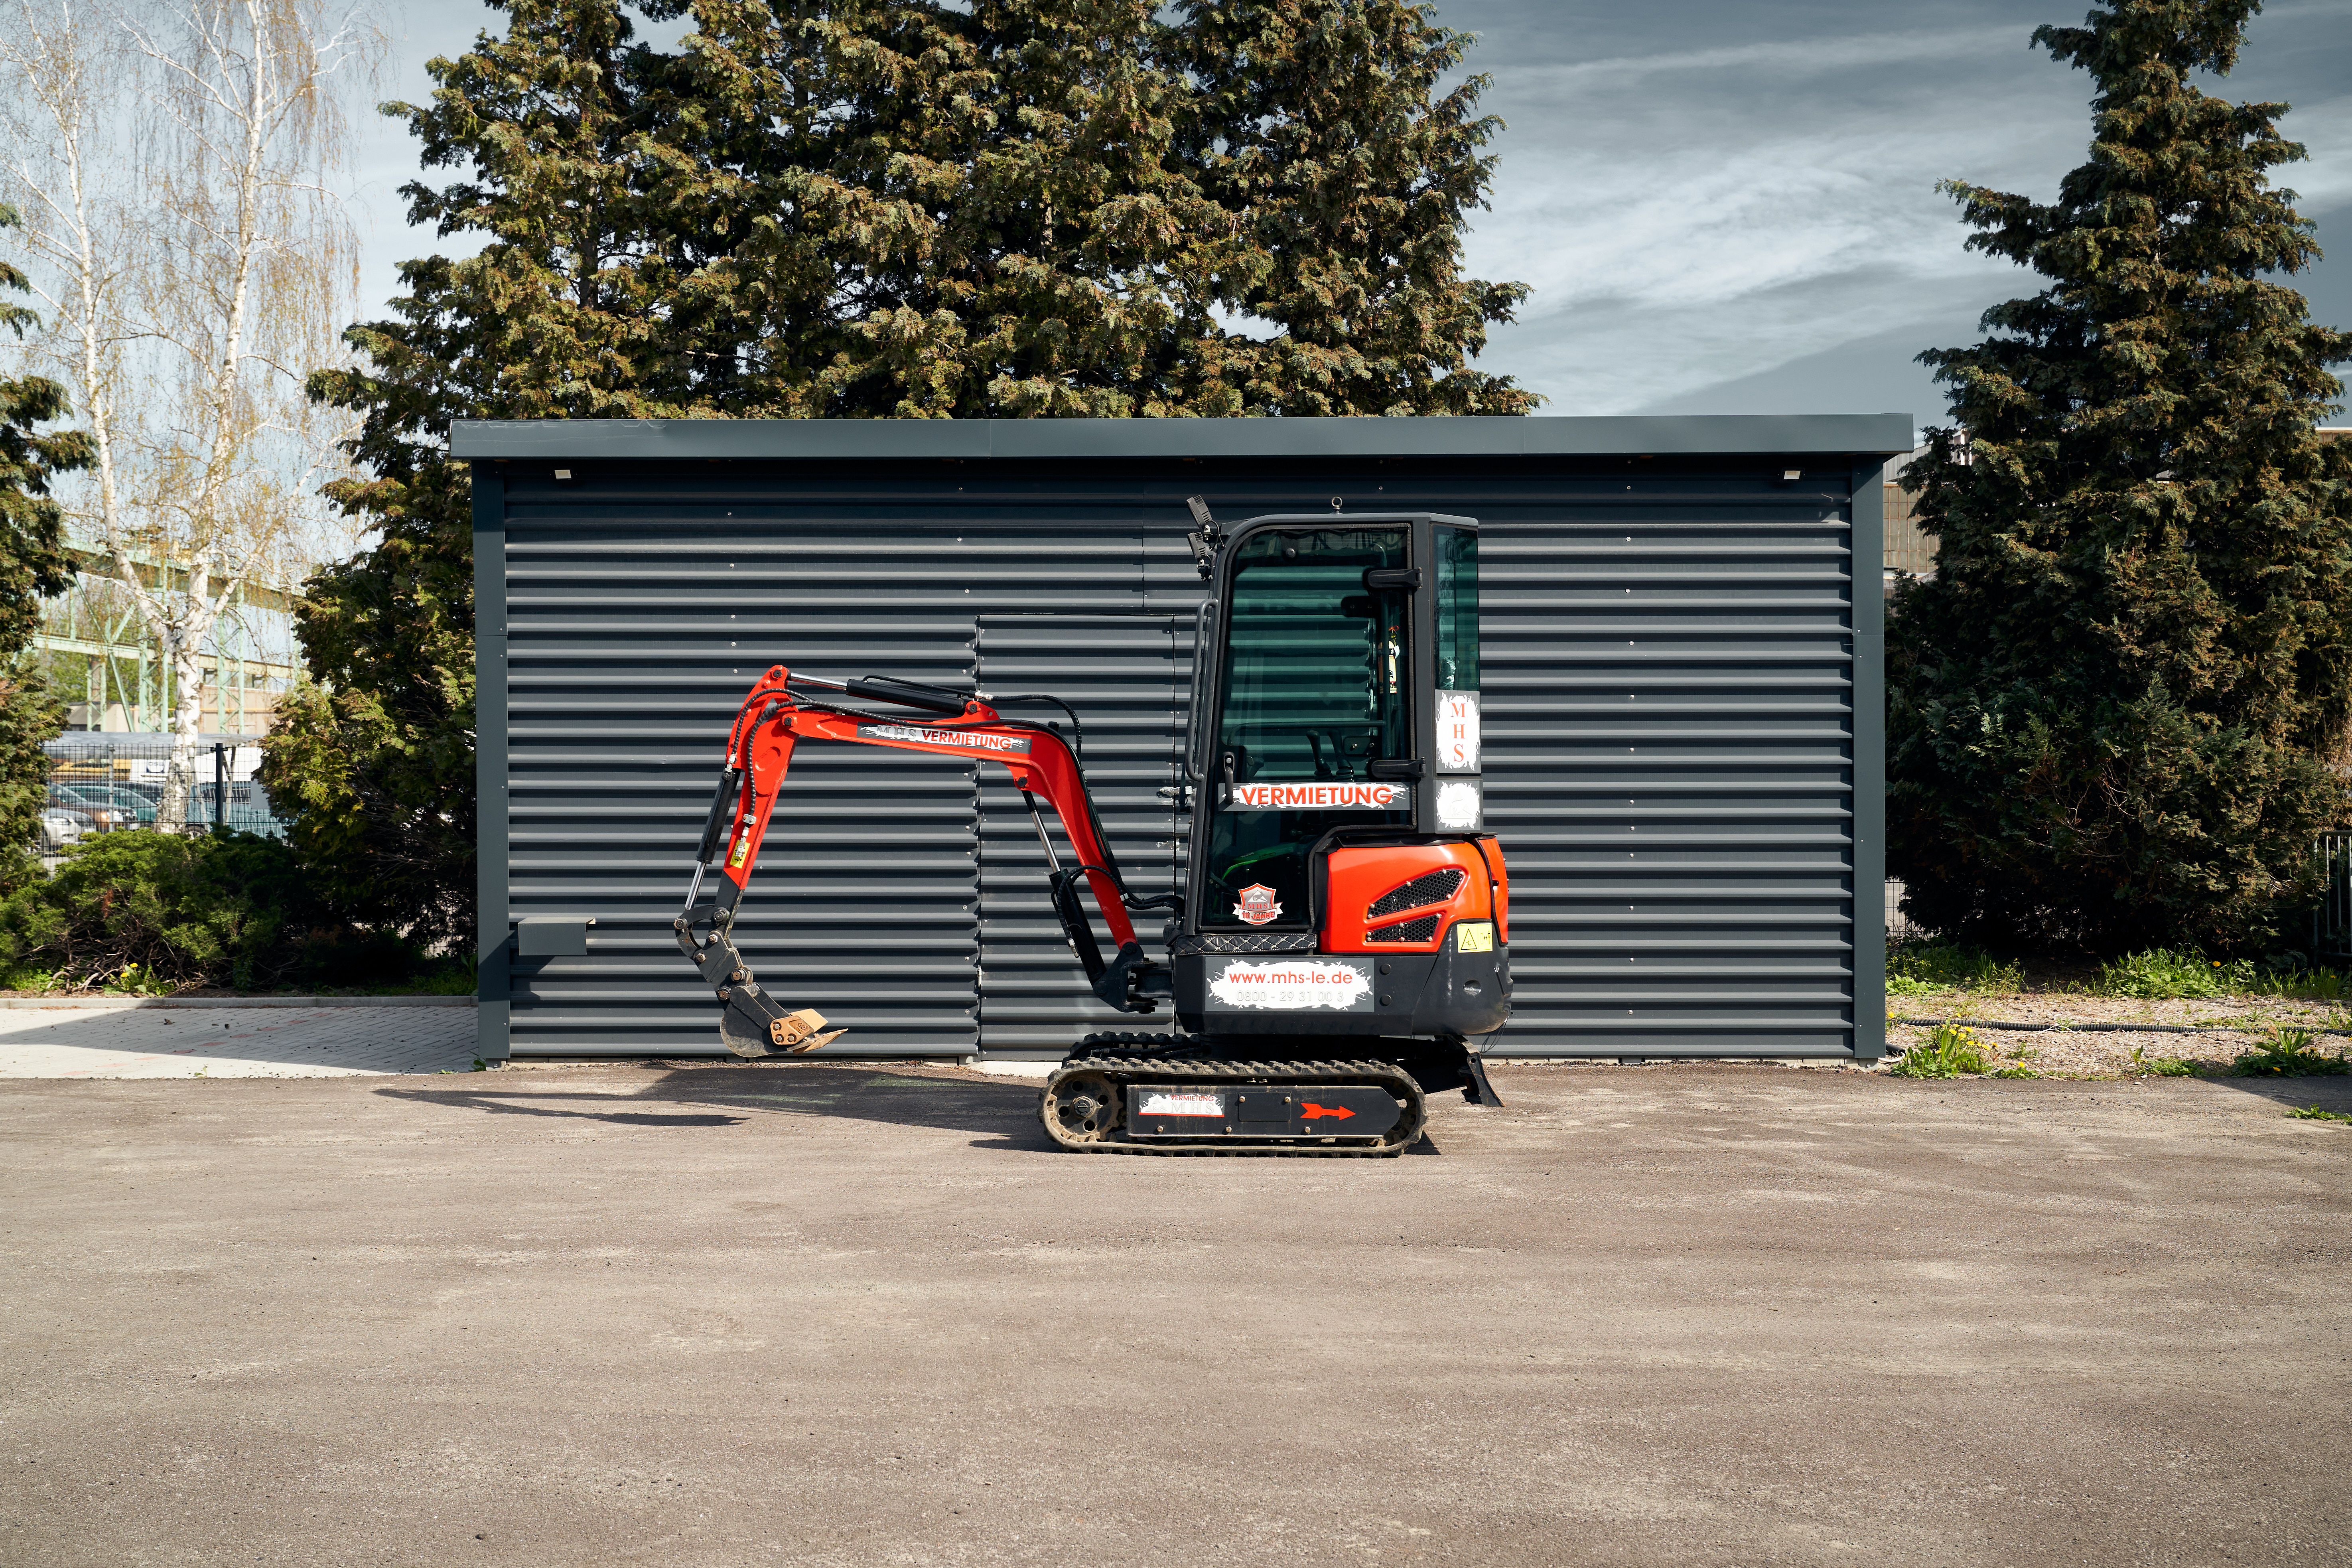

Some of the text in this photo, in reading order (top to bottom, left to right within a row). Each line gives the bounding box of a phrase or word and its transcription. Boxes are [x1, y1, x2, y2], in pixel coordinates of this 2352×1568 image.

[922, 730, 1011, 749] VERMIETUNG
[1240, 786, 1393, 805] VERMIETUNG
[1252, 911, 1276, 920] JAHRE
[1229, 970, 1352, 984] www.mhs-le.de
[1236, 990, 1267, 1002] 0800
[1279, 990, 1295, 1002] 29
[1299, 990, 1312, 1002] 31
[1317, 990, 1333, 1002] 00
[1337, 990, 1344, 1002] 3
